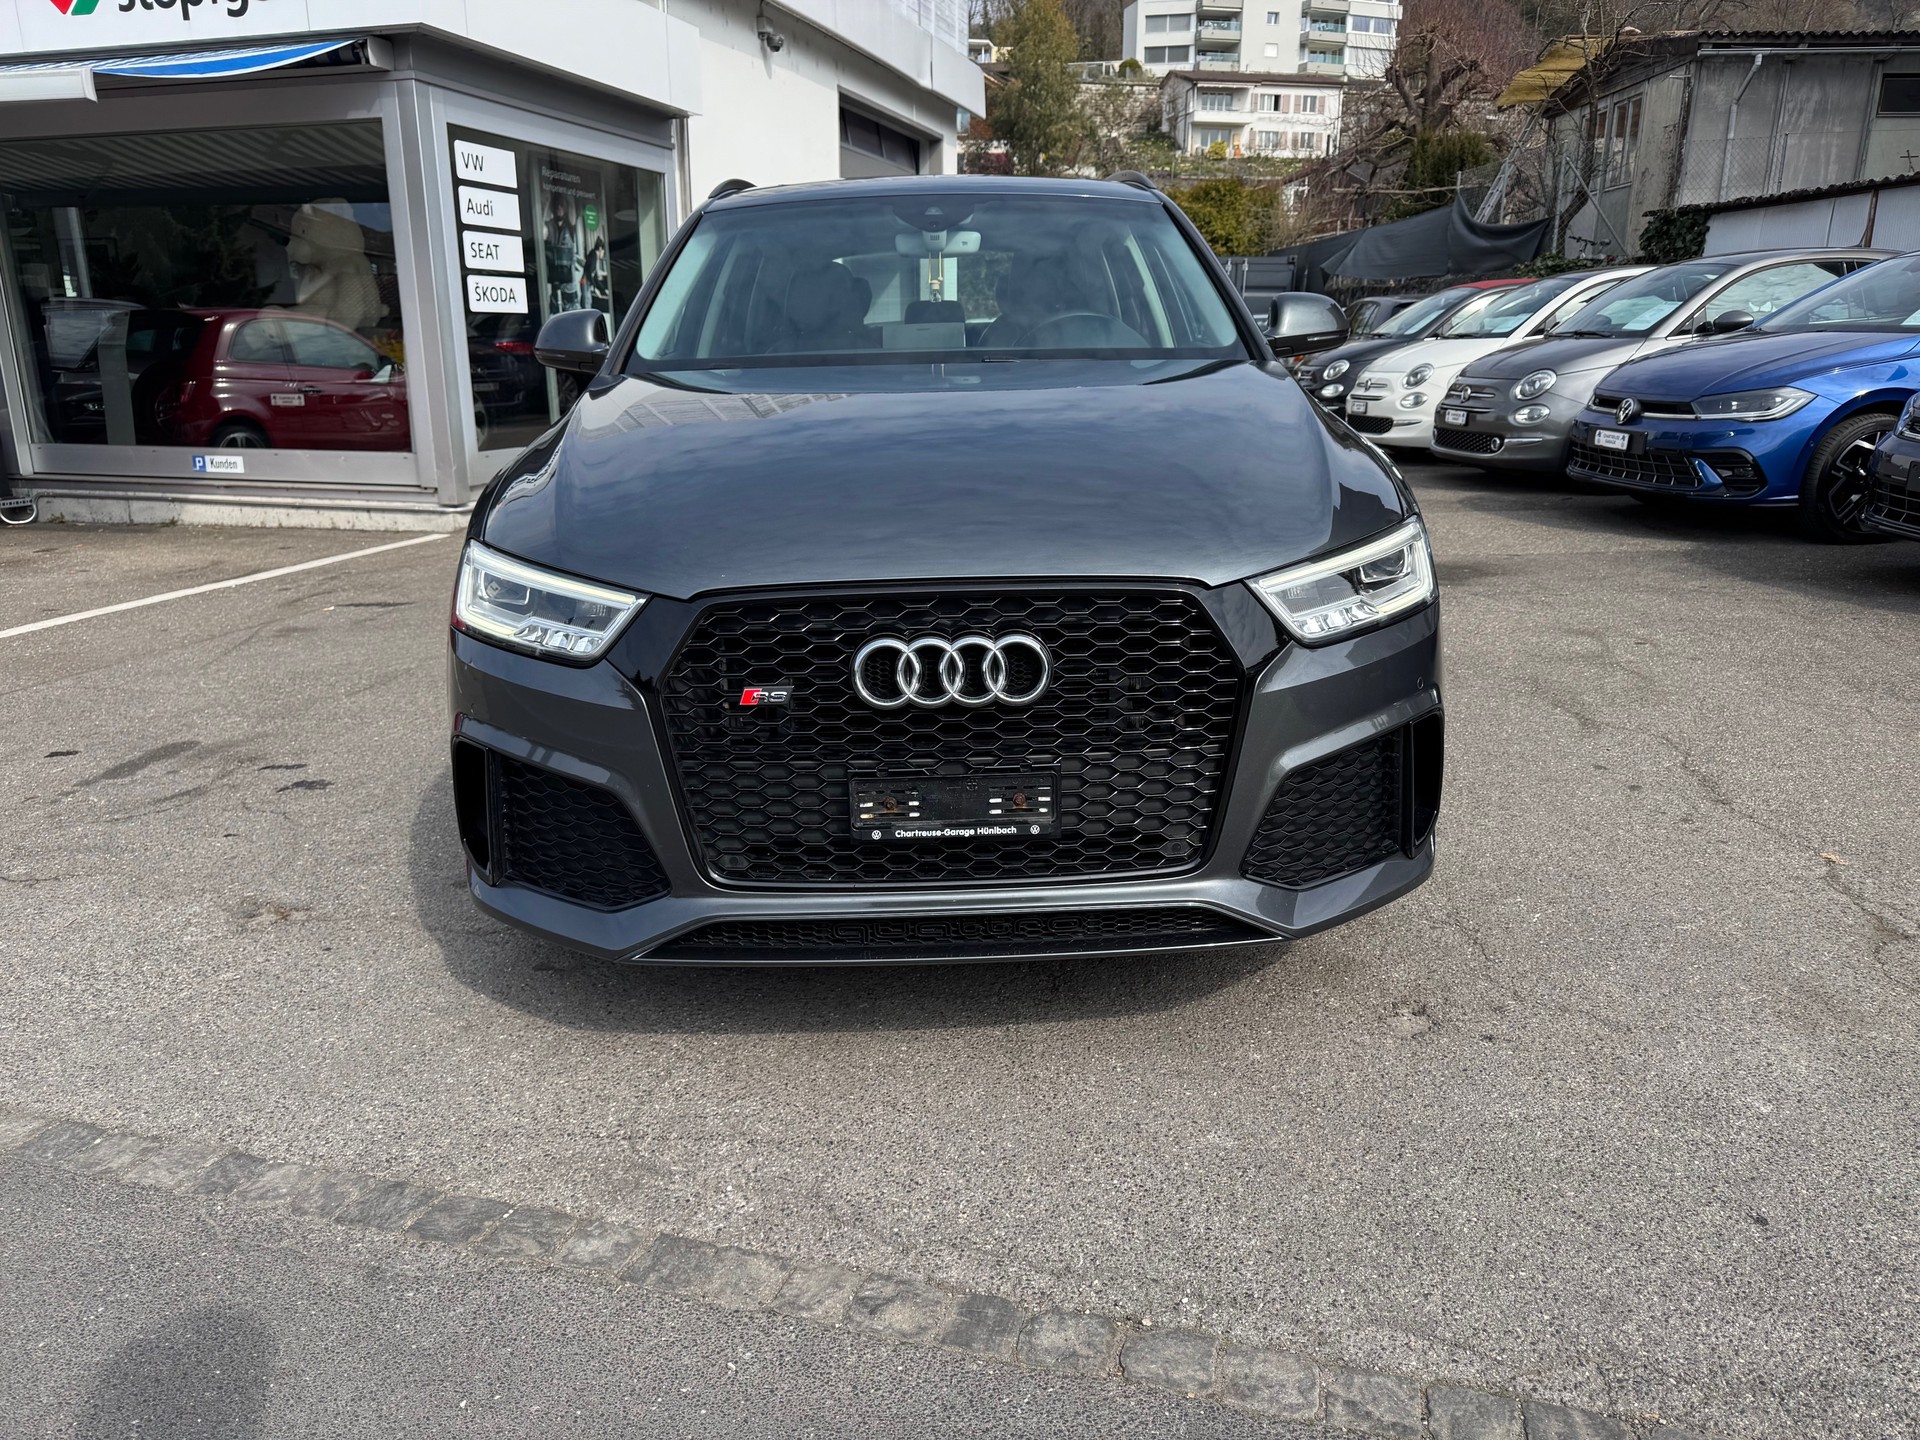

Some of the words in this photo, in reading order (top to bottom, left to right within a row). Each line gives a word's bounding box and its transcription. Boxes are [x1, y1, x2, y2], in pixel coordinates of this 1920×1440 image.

[461, 151, 484, 171] VW
[466, 198, 494, 216] Audi
[470, 242, 500, 260] SEAT
[474, 282, 517, 303] ŠKODA
[194, 457, 204, 471] P
[209, 457, 238, 470] Kunden
[750, 691, 788, 703] RS
[894, 827, 976, 838] Chartreuse-Garage
[832, 914, 1084, 944] quattro
